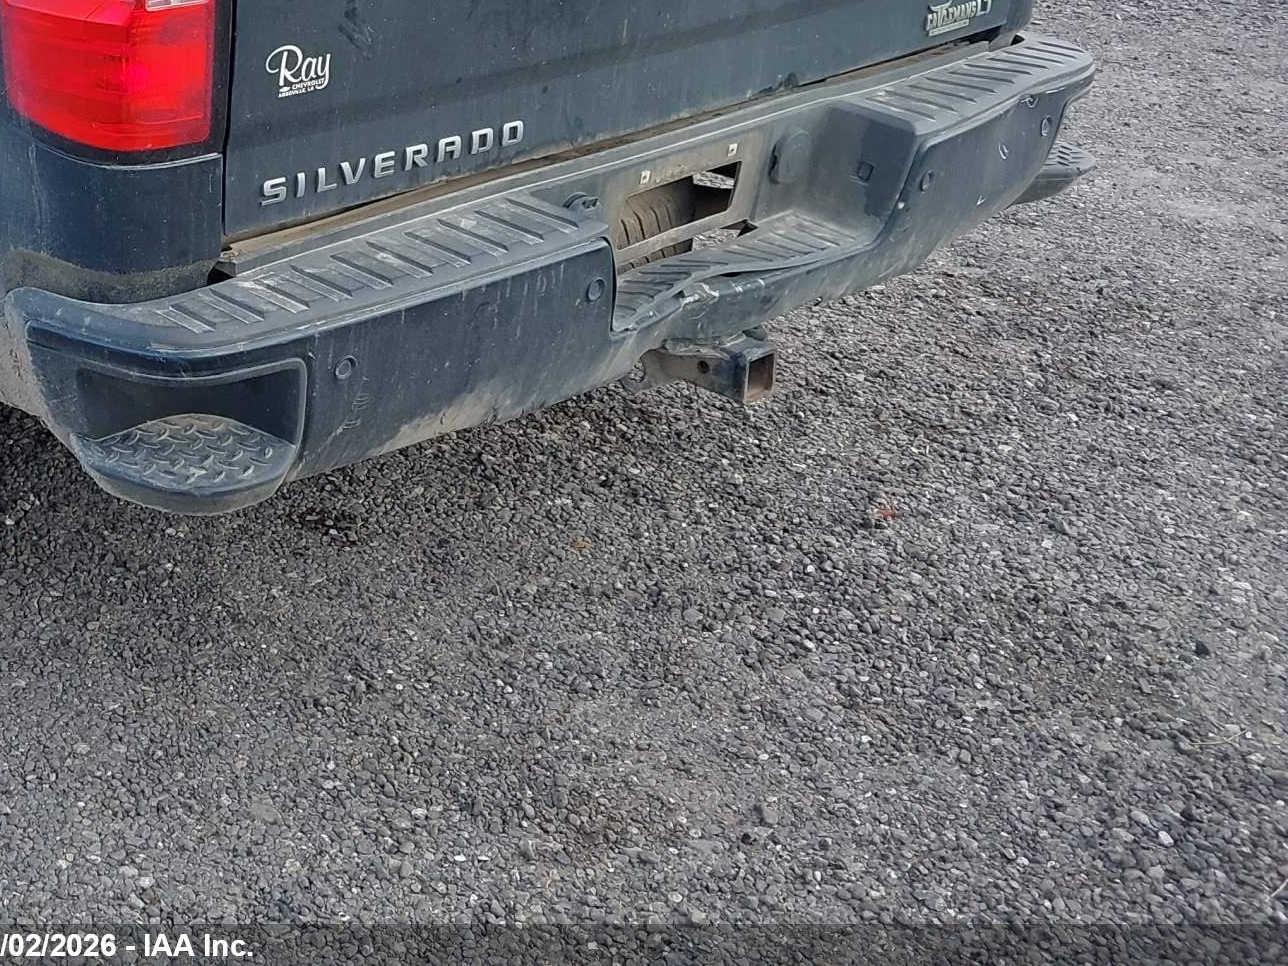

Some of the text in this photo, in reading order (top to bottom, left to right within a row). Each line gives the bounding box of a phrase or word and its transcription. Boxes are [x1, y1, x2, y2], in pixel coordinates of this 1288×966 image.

[265, 44, 331, 90] Ray
[291, 77, 325, 90] CHEVROLET
[260, 119, 525, 206] SILVERADO
